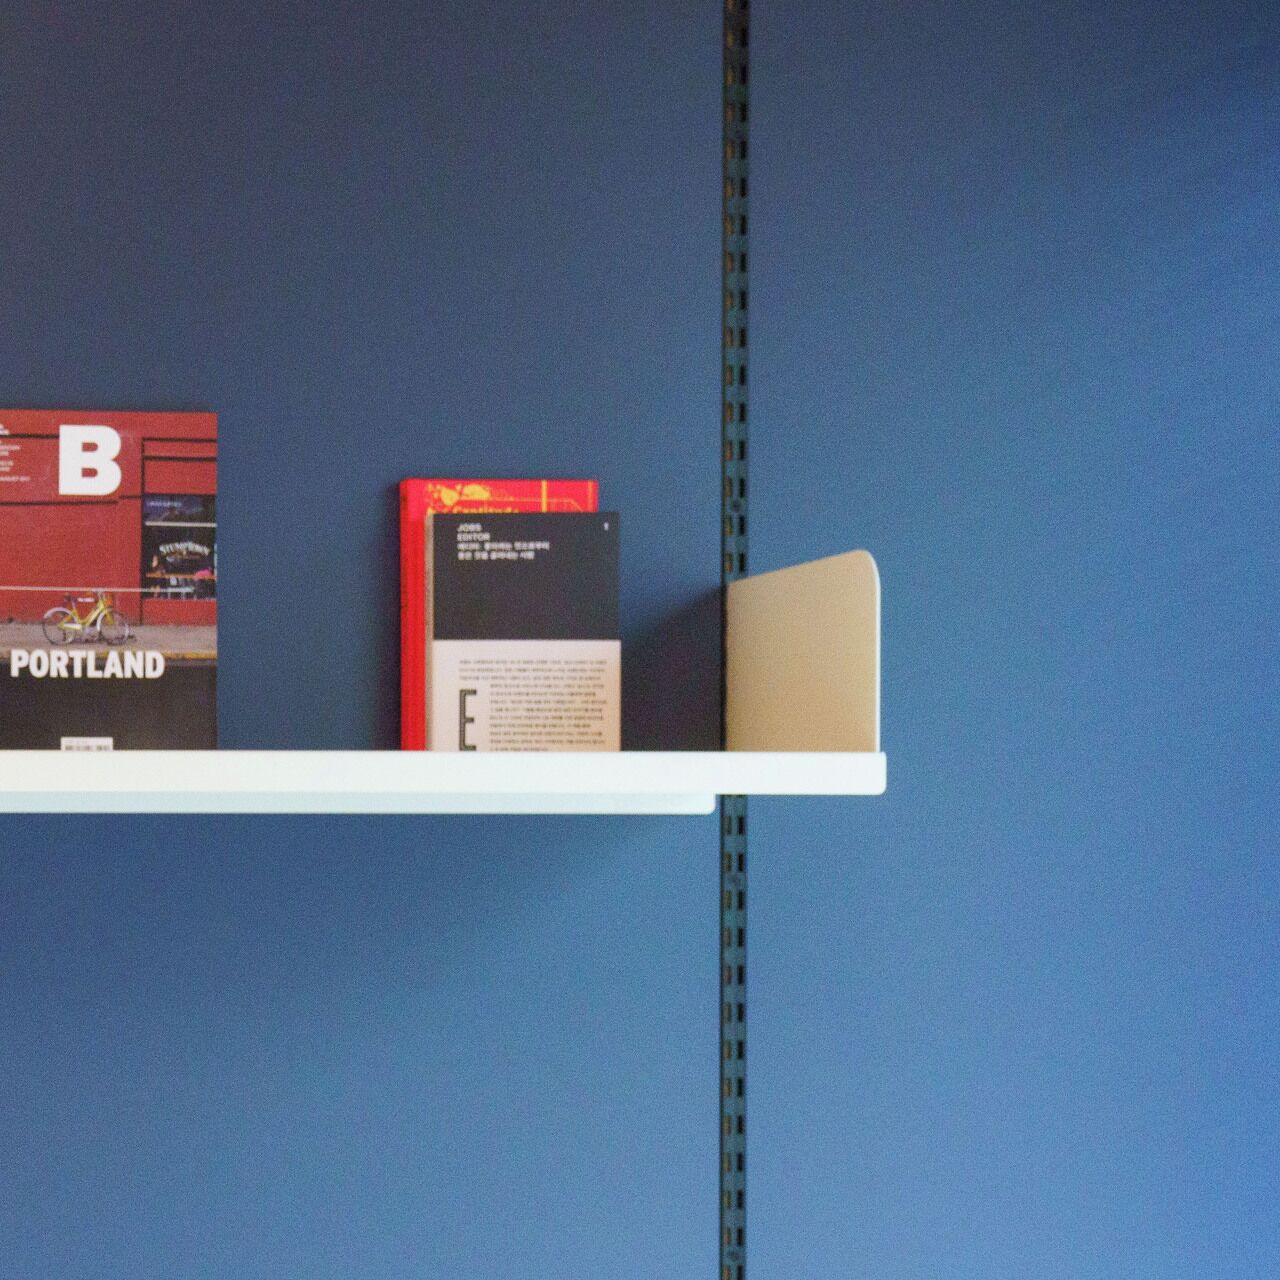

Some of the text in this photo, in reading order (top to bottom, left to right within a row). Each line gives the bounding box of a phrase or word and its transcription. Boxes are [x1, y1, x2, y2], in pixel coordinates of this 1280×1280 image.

[59, 425, 122, 495] B
[457, 532, 490, 541] EDITOR
[10, 649, 165, 678] PORTLAND
